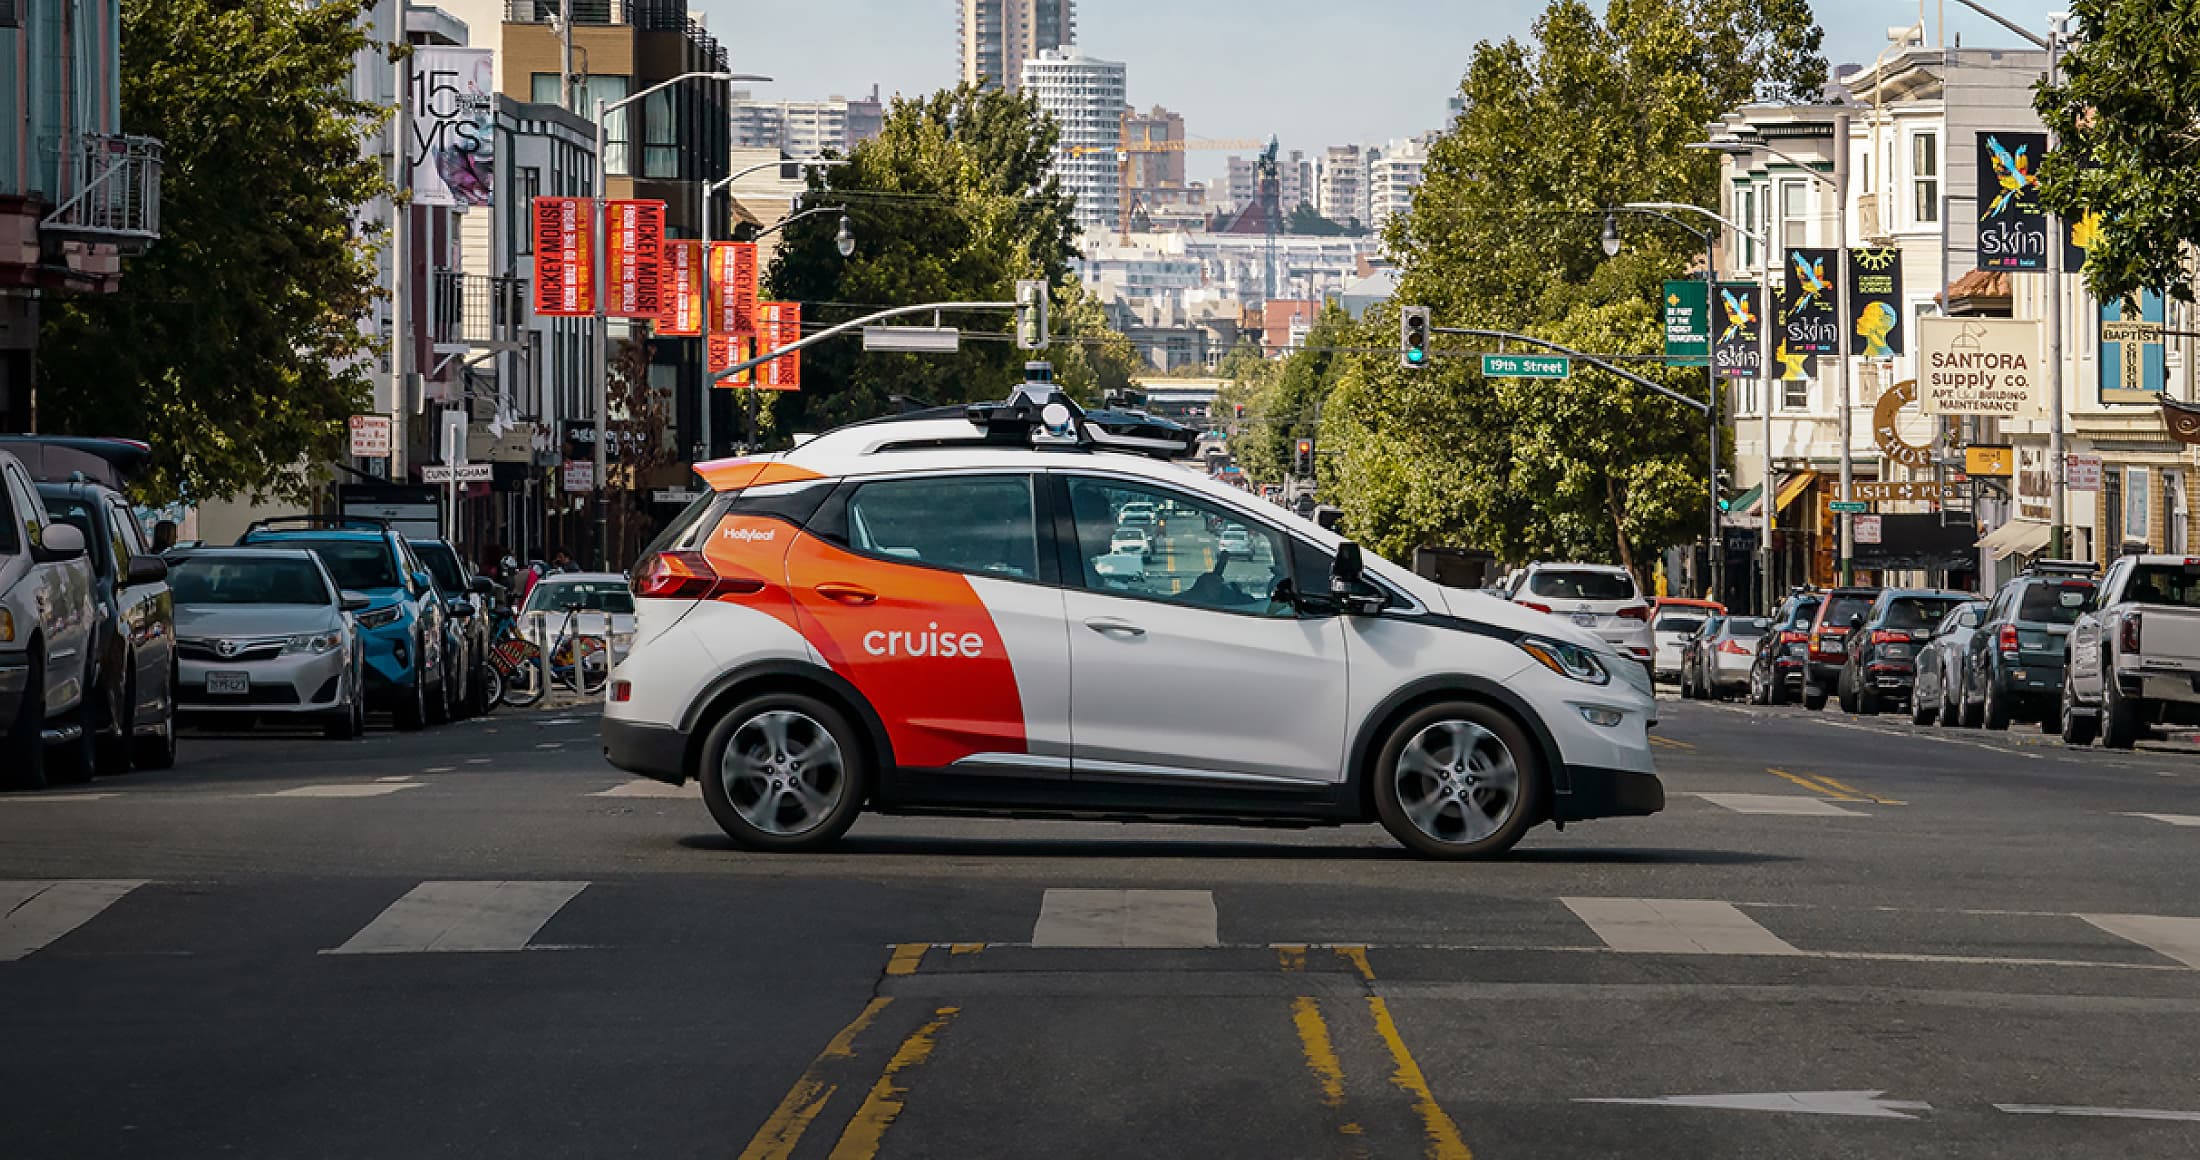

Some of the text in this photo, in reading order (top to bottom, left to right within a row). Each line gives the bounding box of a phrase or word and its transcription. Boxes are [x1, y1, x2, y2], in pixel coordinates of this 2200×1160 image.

[412, 69, 459, 118] 15
[412, 120, 480, 167] yrs
[1980, 221, 2045, 255] skin
[540, 201, 561, 311] MICKEY MOUSE
[638, 206, 658, 313] MICKEY MOUSE
[1787, 316, 1837, 343] skin
[1716, 344, 1761, 367] skin
[1931, 351, 2028, 370] SANTORA
[1490, 359, 1563, 374] 19th Street
[1931, 371, 2030, 389] supply co.
[1939, 400, 2019, 412] MAINTENANCE
[1978, 390, 2028, 401] BUILDING
[425, 468, 489, 480] CUNNNGHAM
[1834, 485, 1890, 498] IISH
[723, 528, 775, 542] Hollyleaf
[863, 621, 984, 657] cruise
